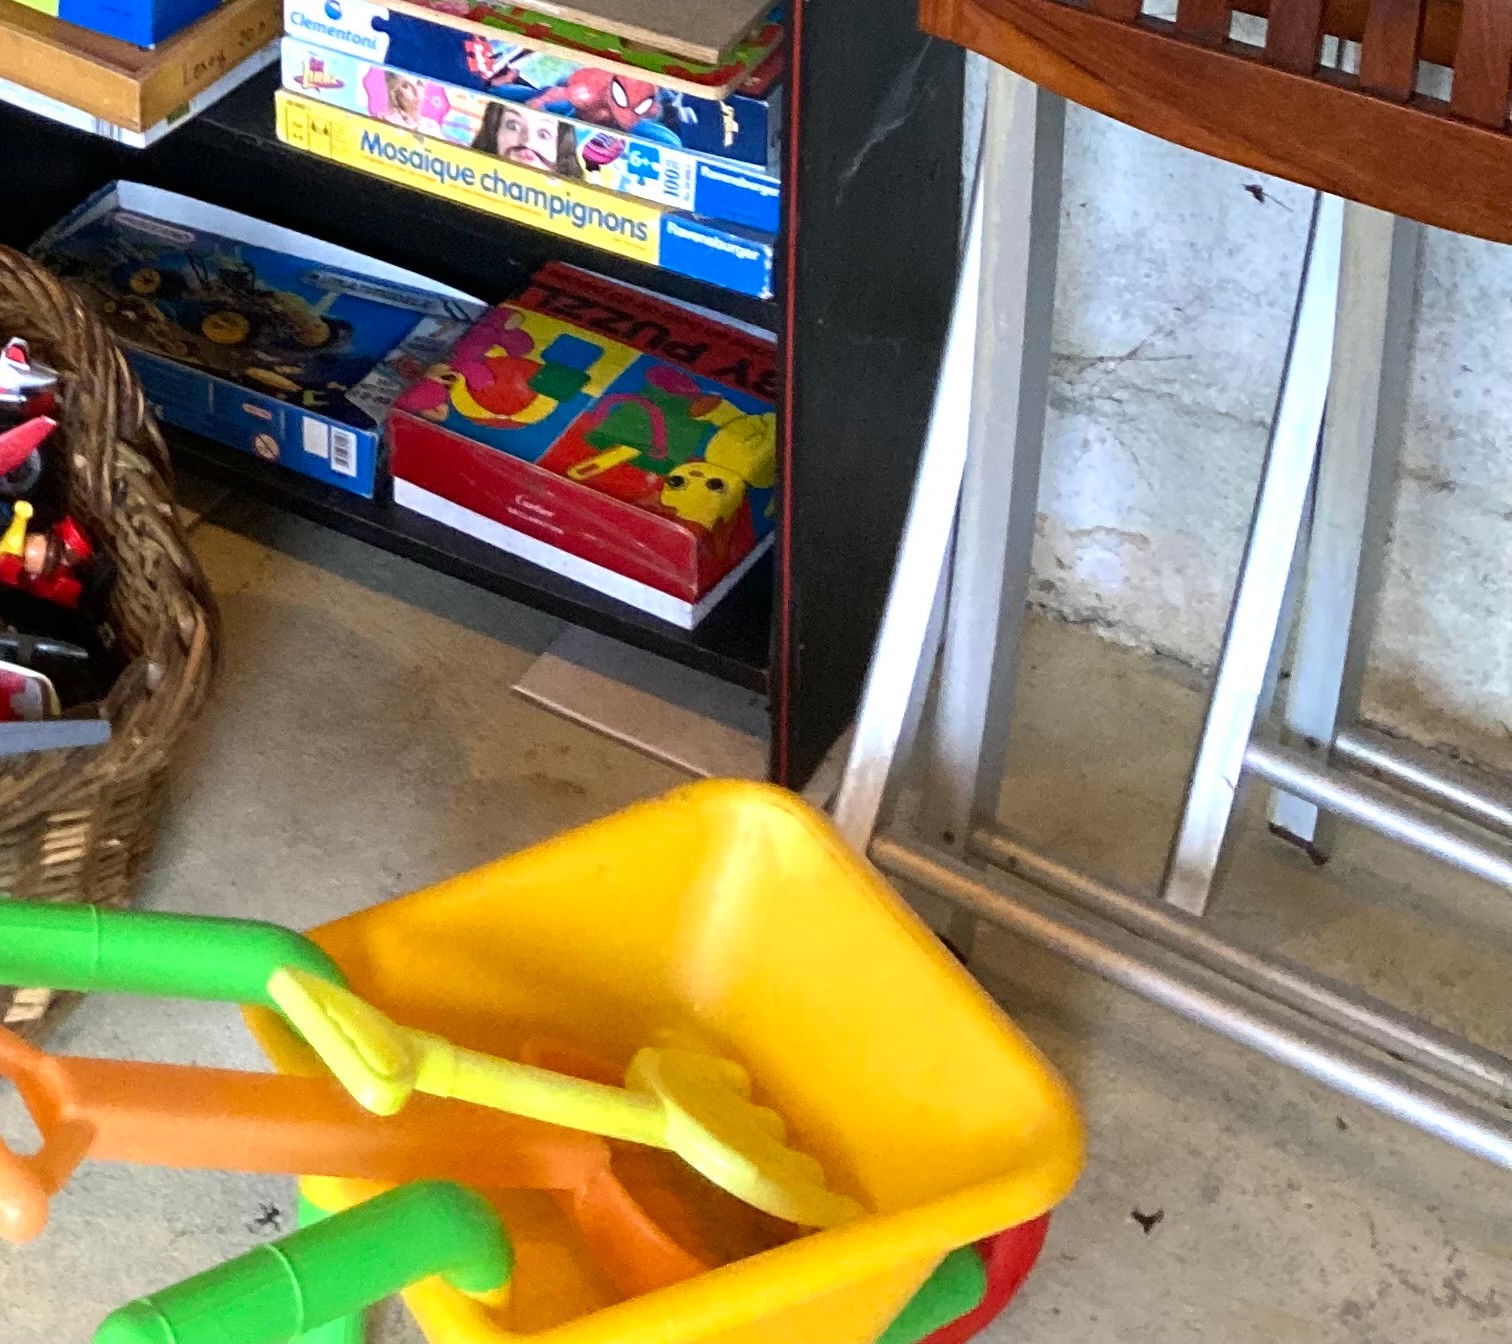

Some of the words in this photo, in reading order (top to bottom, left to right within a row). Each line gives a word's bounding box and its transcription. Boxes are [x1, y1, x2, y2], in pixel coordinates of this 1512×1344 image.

[290, 10, 378, 51] Clementoni
[360, 128, 476, 186] Mosaïque
[480, 167, 648, 243] champignons
[699, 164, 781, 197] Ravensburger
[665, 220, 761, 262] Ravensburger
